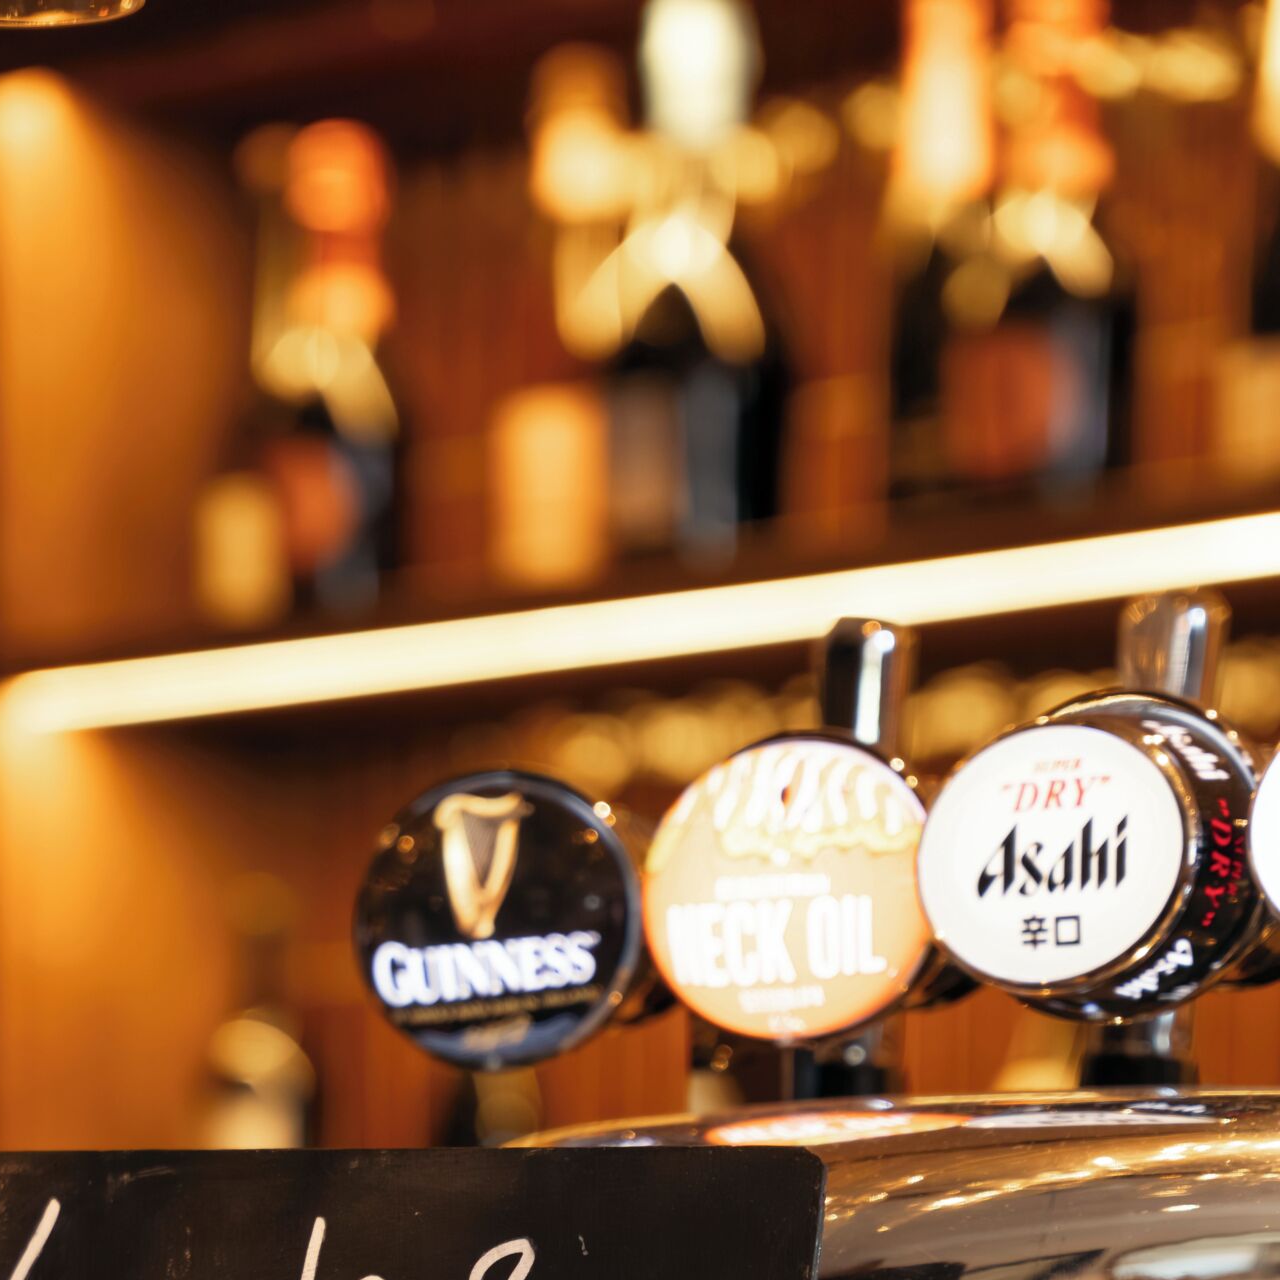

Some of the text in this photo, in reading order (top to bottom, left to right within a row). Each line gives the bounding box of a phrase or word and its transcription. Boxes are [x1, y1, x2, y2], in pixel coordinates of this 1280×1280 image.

[976, 813, 1129, 899] Asahi
[372, 930, 600, 1009] GUINNESS
[1020, 915, 1082, 951] 辛口
